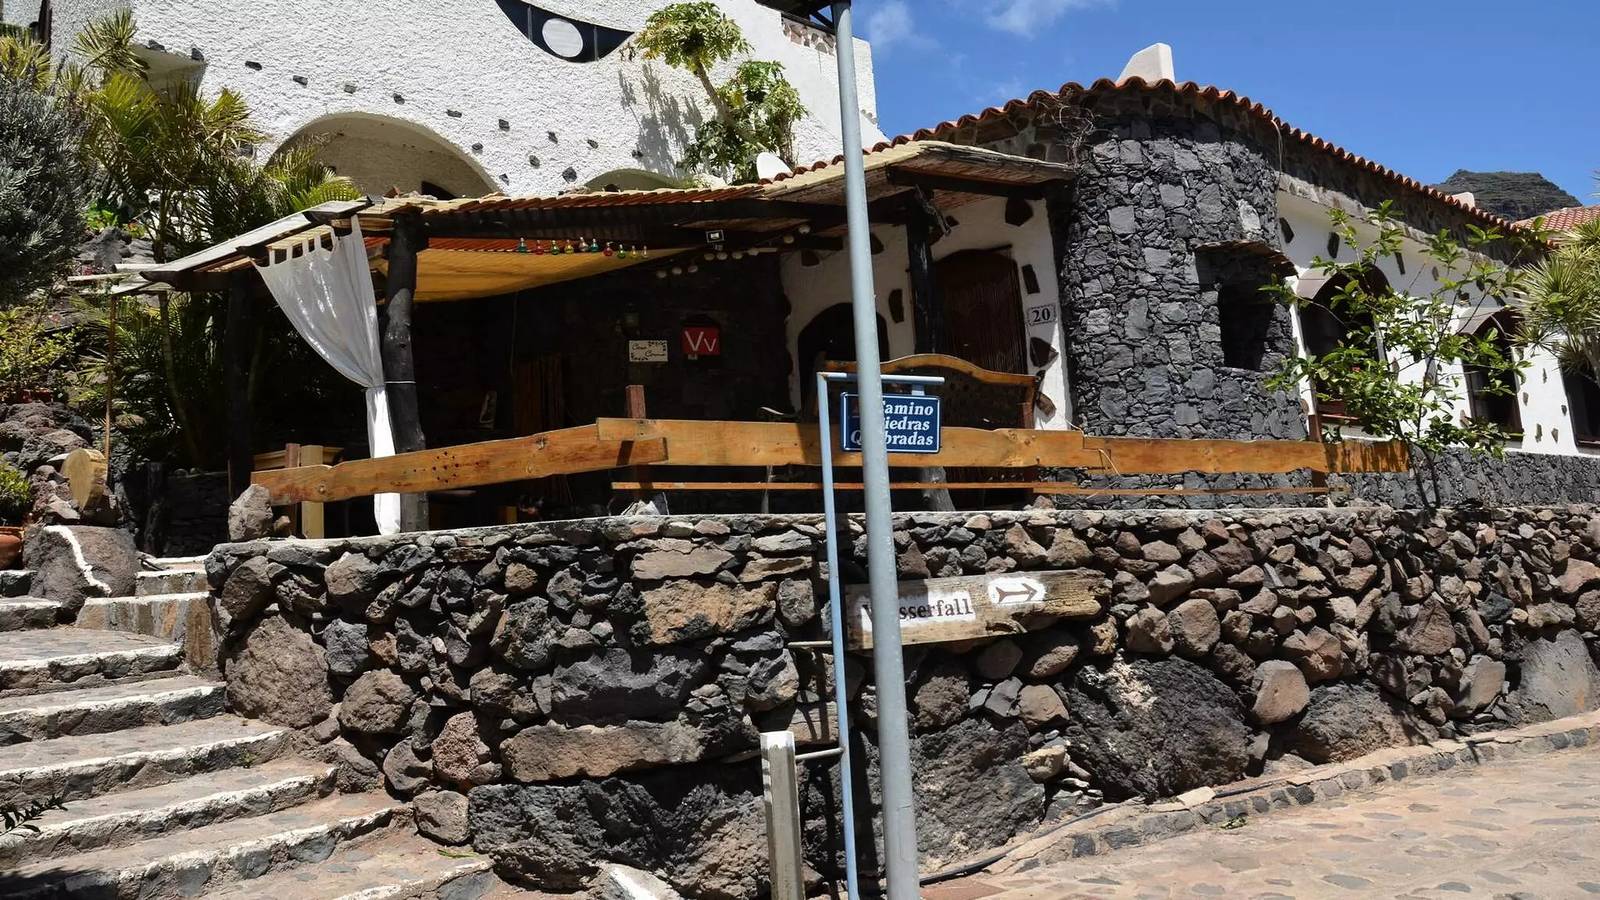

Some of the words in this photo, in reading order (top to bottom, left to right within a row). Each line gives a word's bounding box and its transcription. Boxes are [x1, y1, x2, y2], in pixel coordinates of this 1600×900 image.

[1031, 308, 1051, 322] 20
[882, 401, 934, 416] amino
[884, 416, 930, 431] iedras
[850, 430, 934, 446] Qbradas
[862, 598, 974, 620] sserfall
